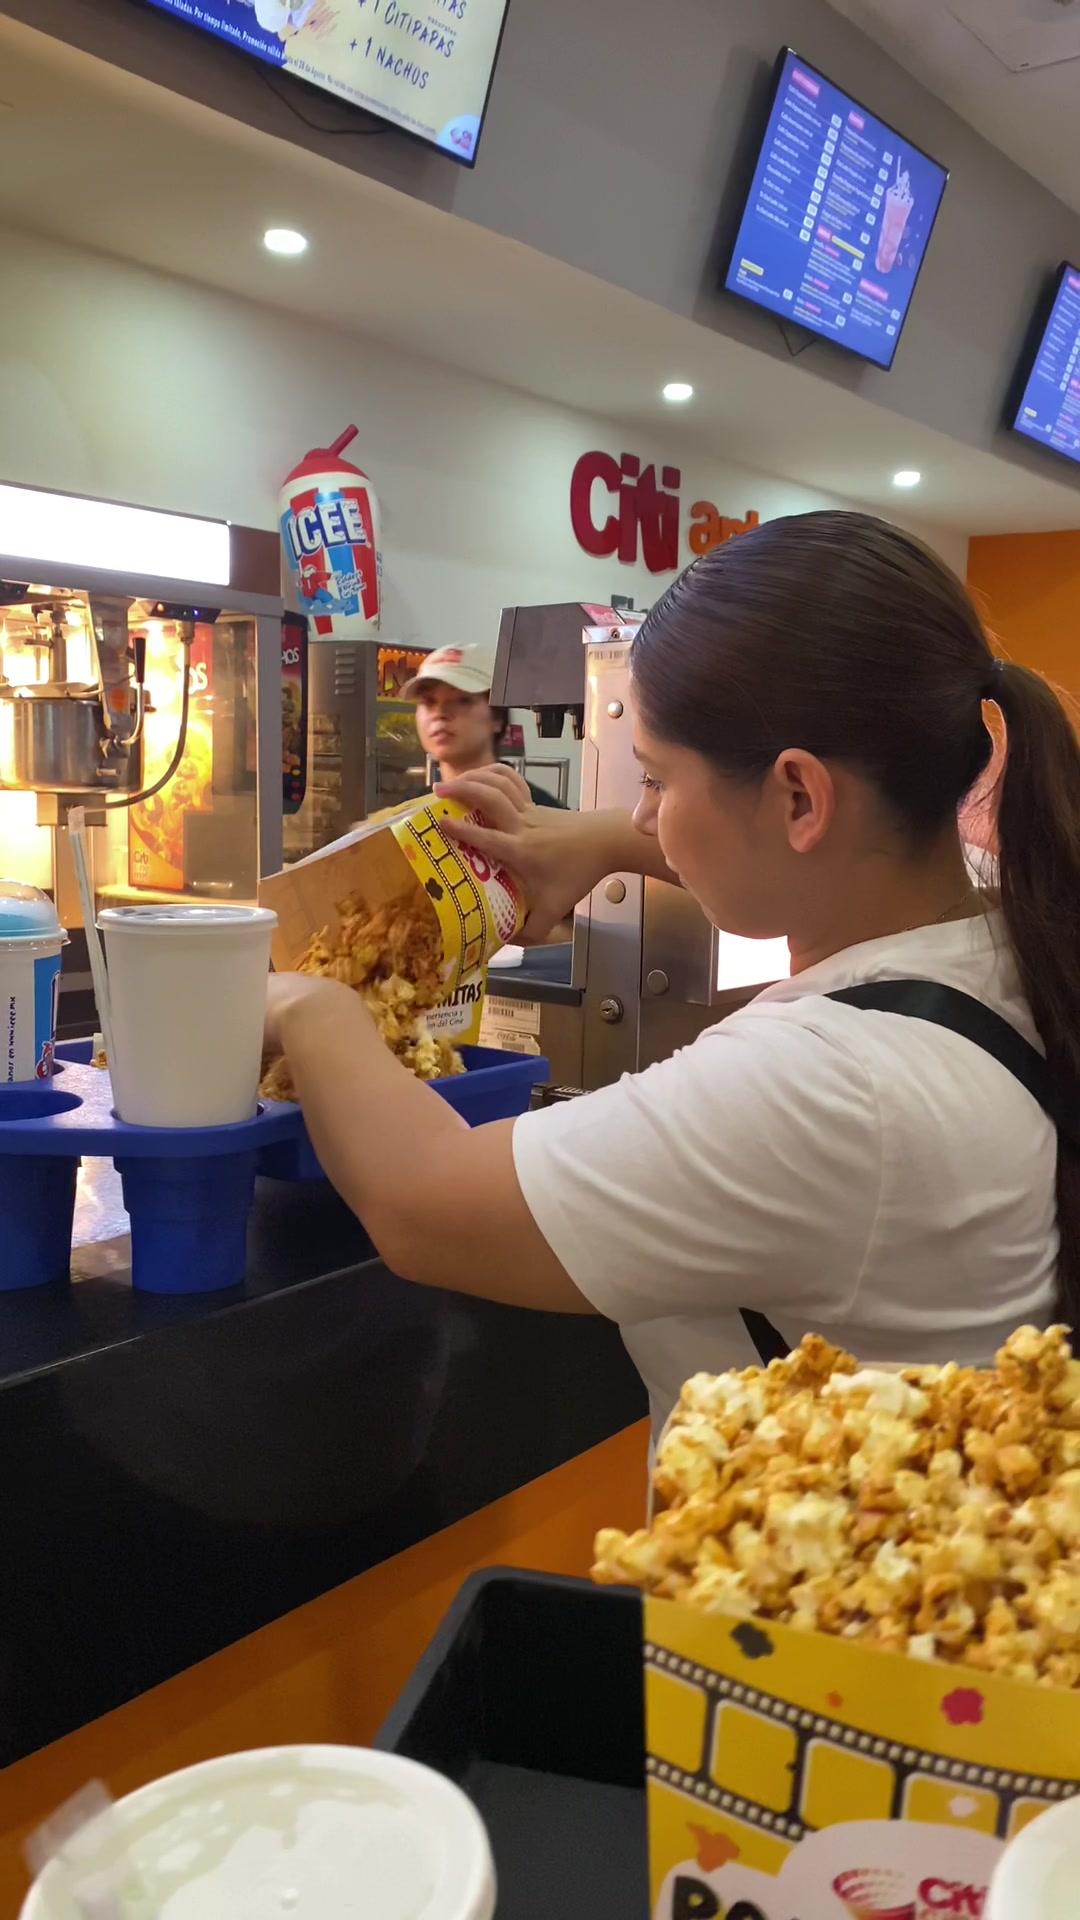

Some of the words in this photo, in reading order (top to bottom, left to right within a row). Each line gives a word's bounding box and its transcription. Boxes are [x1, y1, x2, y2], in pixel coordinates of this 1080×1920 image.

[365, 37, 372, 57] 1
[376, 46, 429, 89] NACHOS
[288, 500, 366, 561] ICEE
[570, 451, 681, 574] Citi
